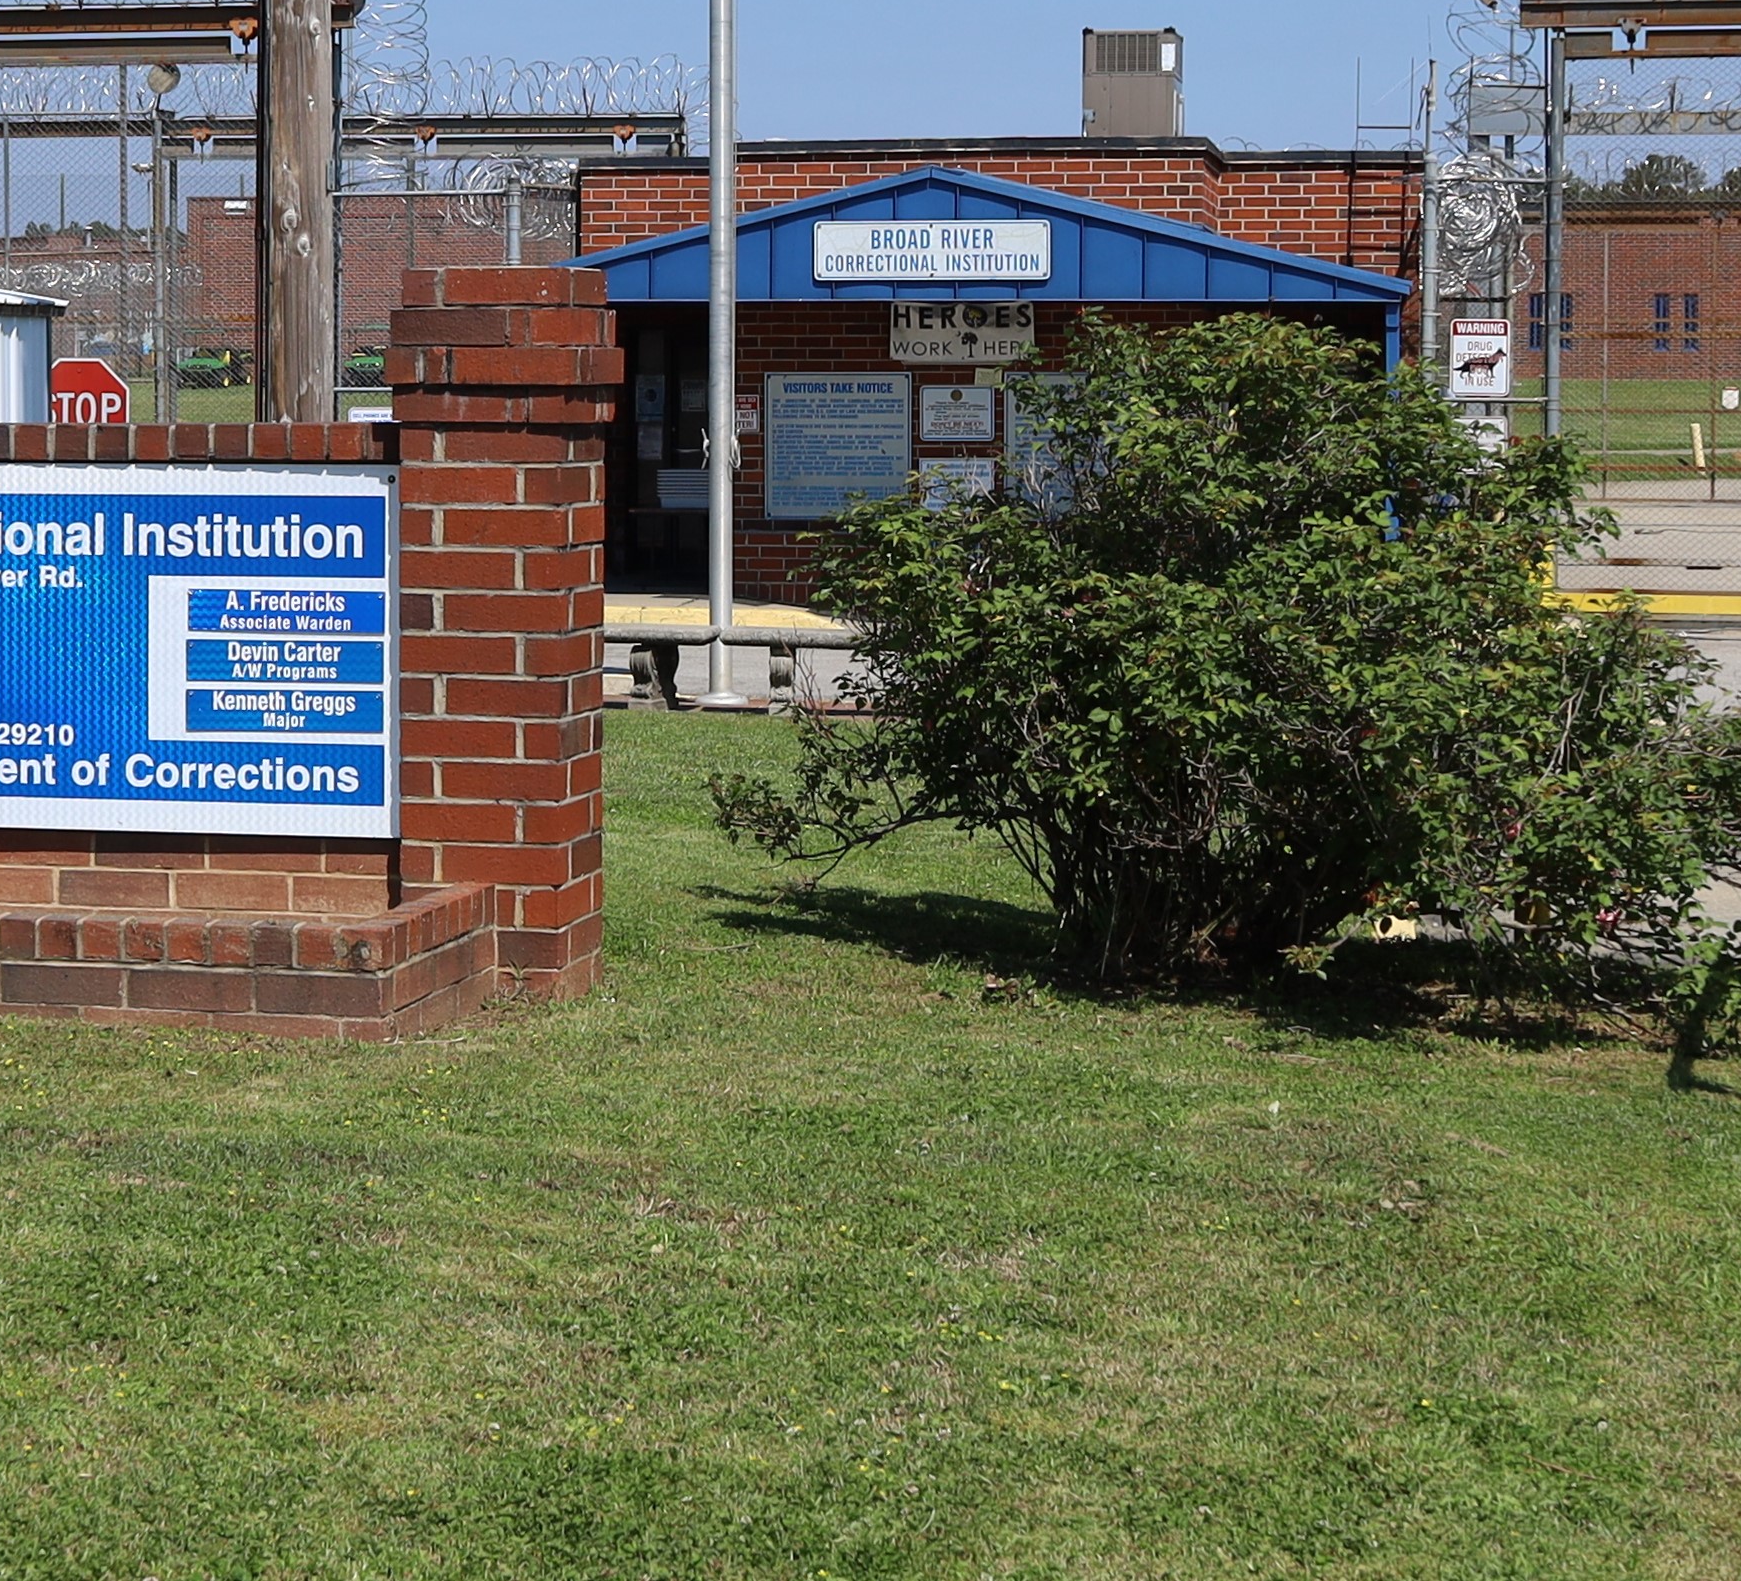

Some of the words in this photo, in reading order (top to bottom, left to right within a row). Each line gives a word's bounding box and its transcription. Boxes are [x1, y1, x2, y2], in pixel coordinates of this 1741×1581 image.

[871, 229, 930, 249] BROAD
[941, 229, 993, 249] RIVER
[825, 254, 937, 272] CORRECTIONAL
[946, 254, 1039, 271] INSTITUTION
[892, 304, 1032, 329] HEROES
[1456, 322, 1505, 334] WARNING
[892, 341, 952, 356] WORK
[984, 340, 1020, 355] HER
[1467, 341, 1492, 351] DRUG
[783, 382, 827, 394] VISITORS
[831, 382, 854, 394] TAKE
[857, 382, 893, 394] NOTICE
[1476, 376, 1494, 386] USE
[123, 512, 363, 559] Institution
[39, 565, 83, 588] Rd.
[226, 591, 244, 611] A.
[250, 591, 345, 612] Fredericks
[220, 615, 290, 630] Associate
[295, 615, 351, 631] Warden
[227, 641, 278, 662] Devin
[284, 642, 342, 662] Carter
[232, 663, 262, 678] A/W
[266, 664, 337, 680] Programs
[212, 690, 285, 711] Kenneth
[291, 691, 356, 716] Greggs
[263, 713, 305, 730] Major
[71, 753, 110, 787] of
[125, 754, 360, 794] Corrections
